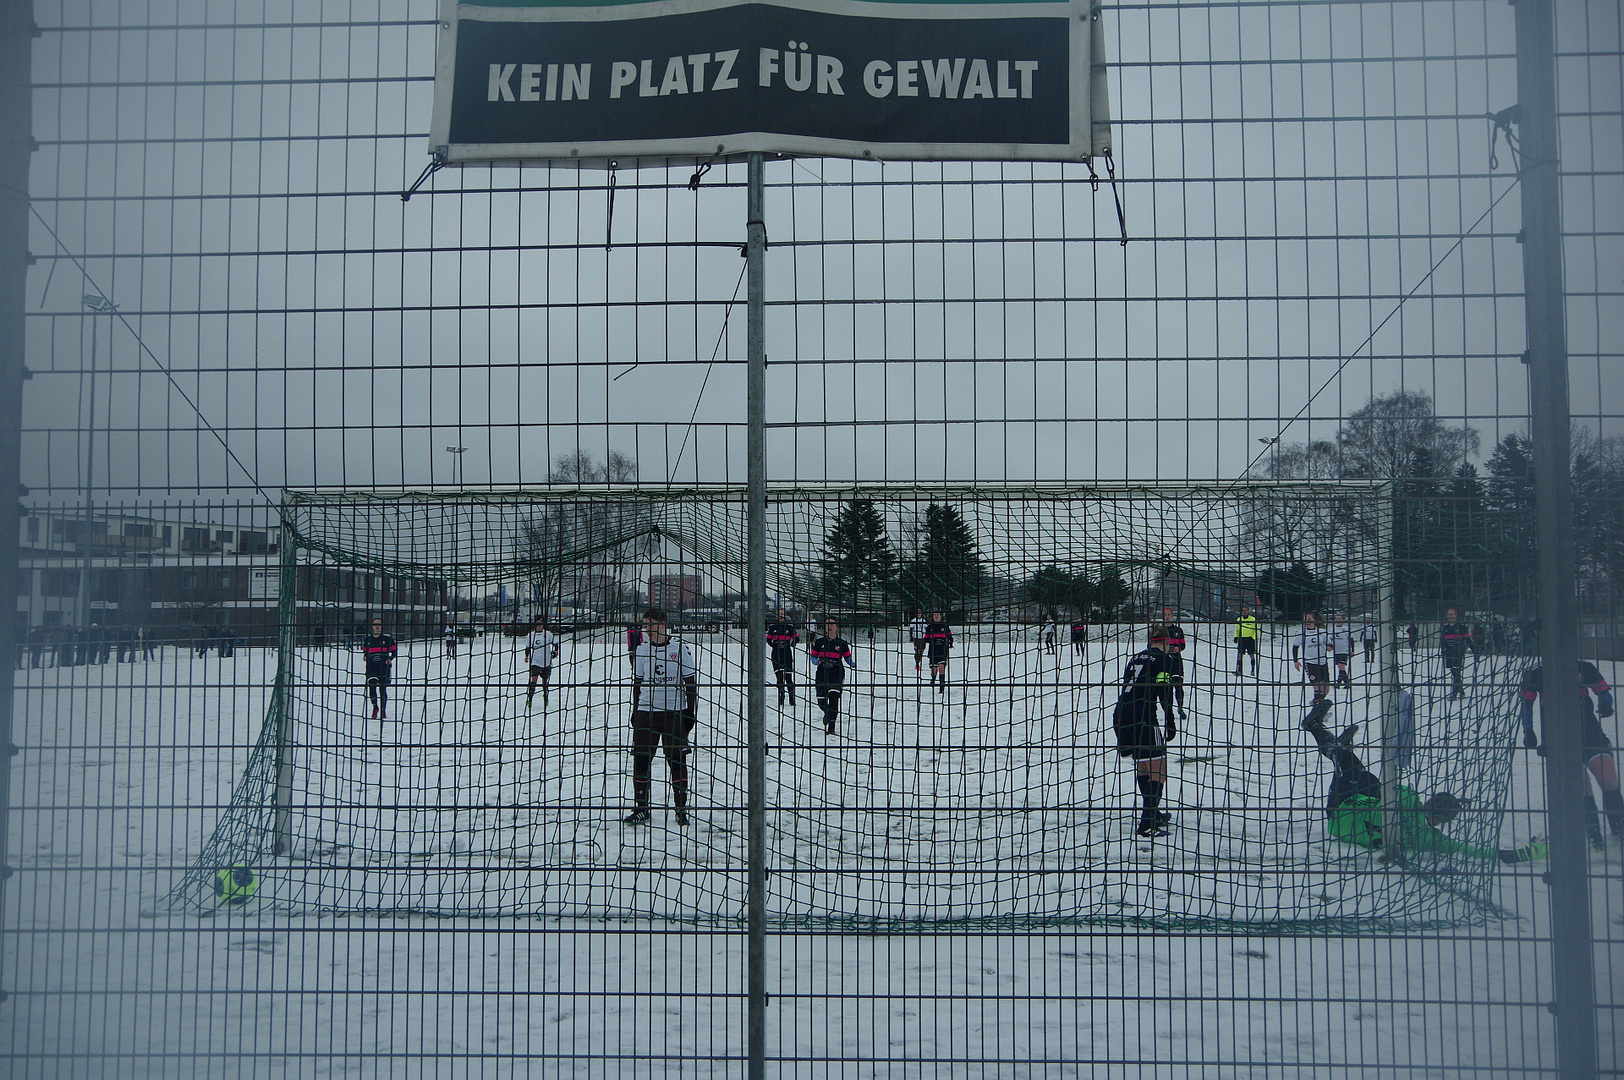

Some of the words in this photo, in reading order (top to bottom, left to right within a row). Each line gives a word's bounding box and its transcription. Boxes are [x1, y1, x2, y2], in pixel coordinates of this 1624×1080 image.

[487, 62, 592, 102] KEIN
[609, 48, 740, 99] PLATZ
[759, 40, 846, 96] FÜR
[863, 58, 1040, 99] GEWALT
